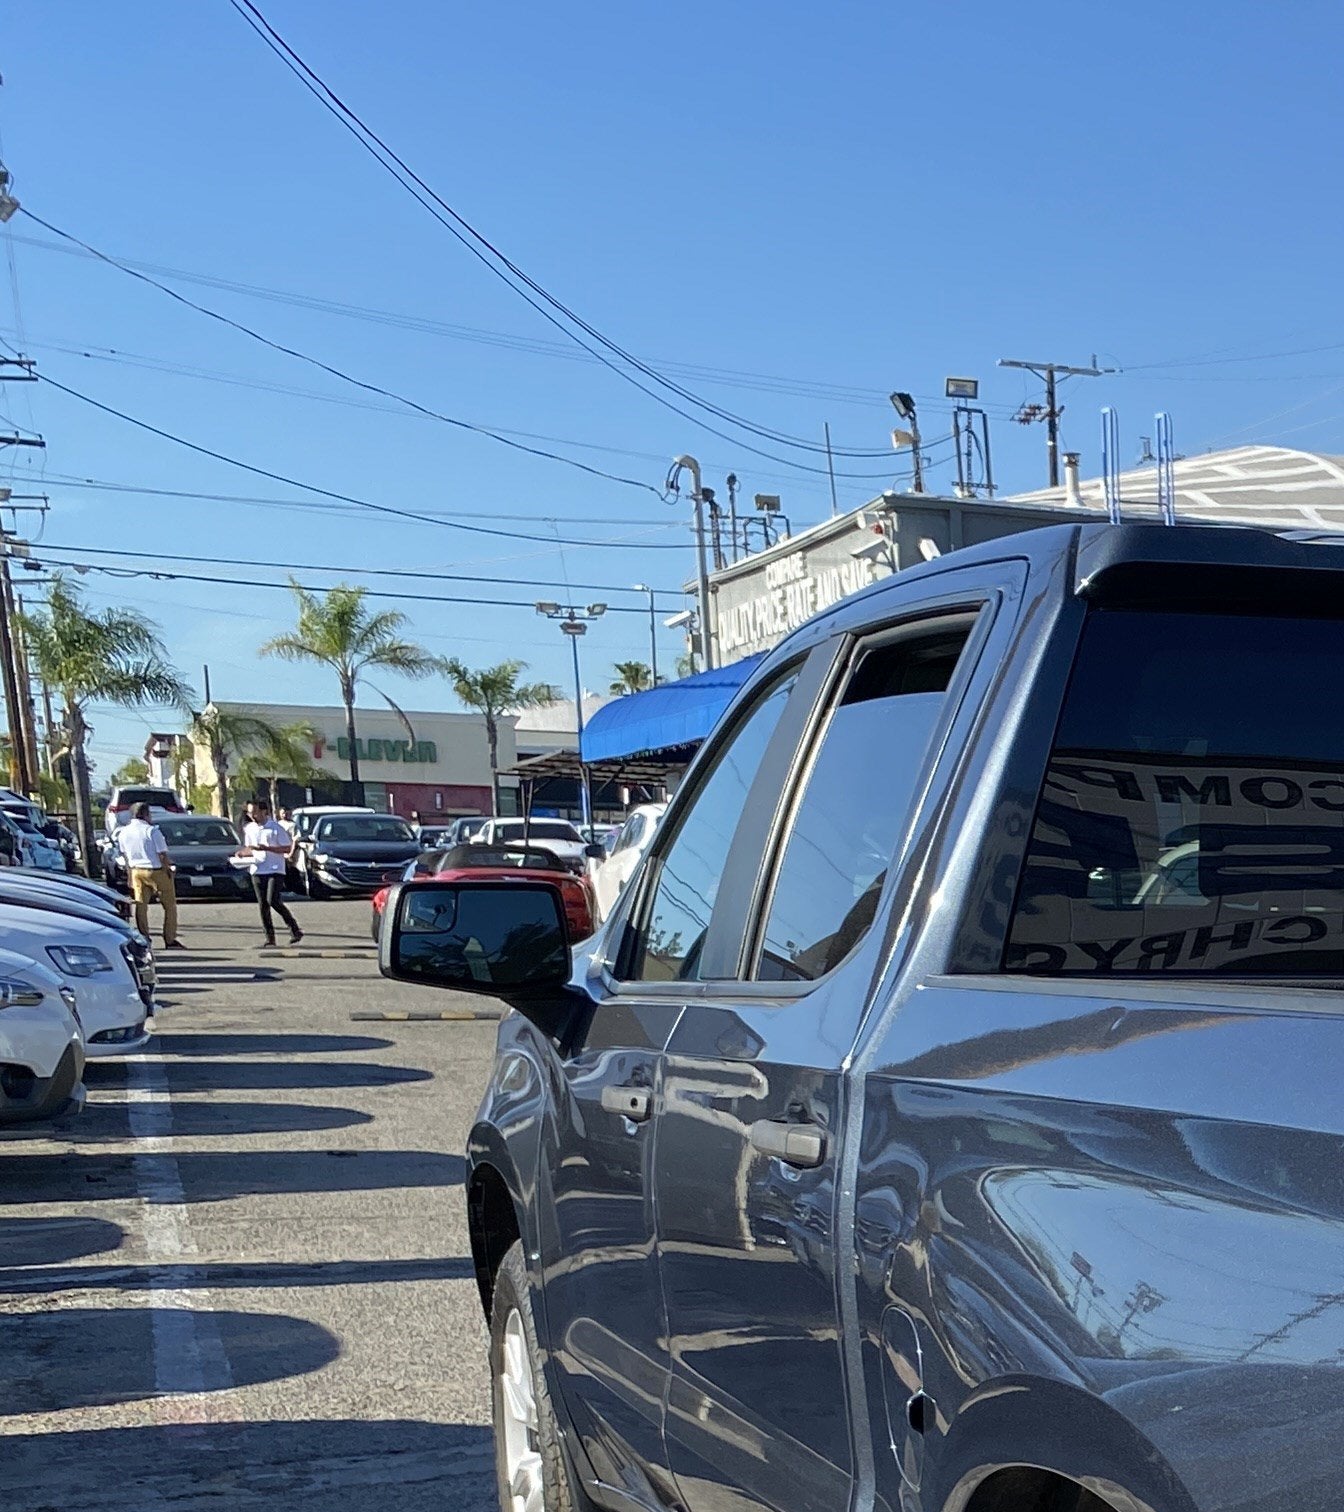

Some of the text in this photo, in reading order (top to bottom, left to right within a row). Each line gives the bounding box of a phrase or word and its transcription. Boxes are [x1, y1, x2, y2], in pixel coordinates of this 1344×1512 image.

[766, 551, 806, 589] COMPARE
[787, 578, 815, 631] RATE
[817, 569, 842, 611] AND
[842, 558, 873, 597] SAVE
